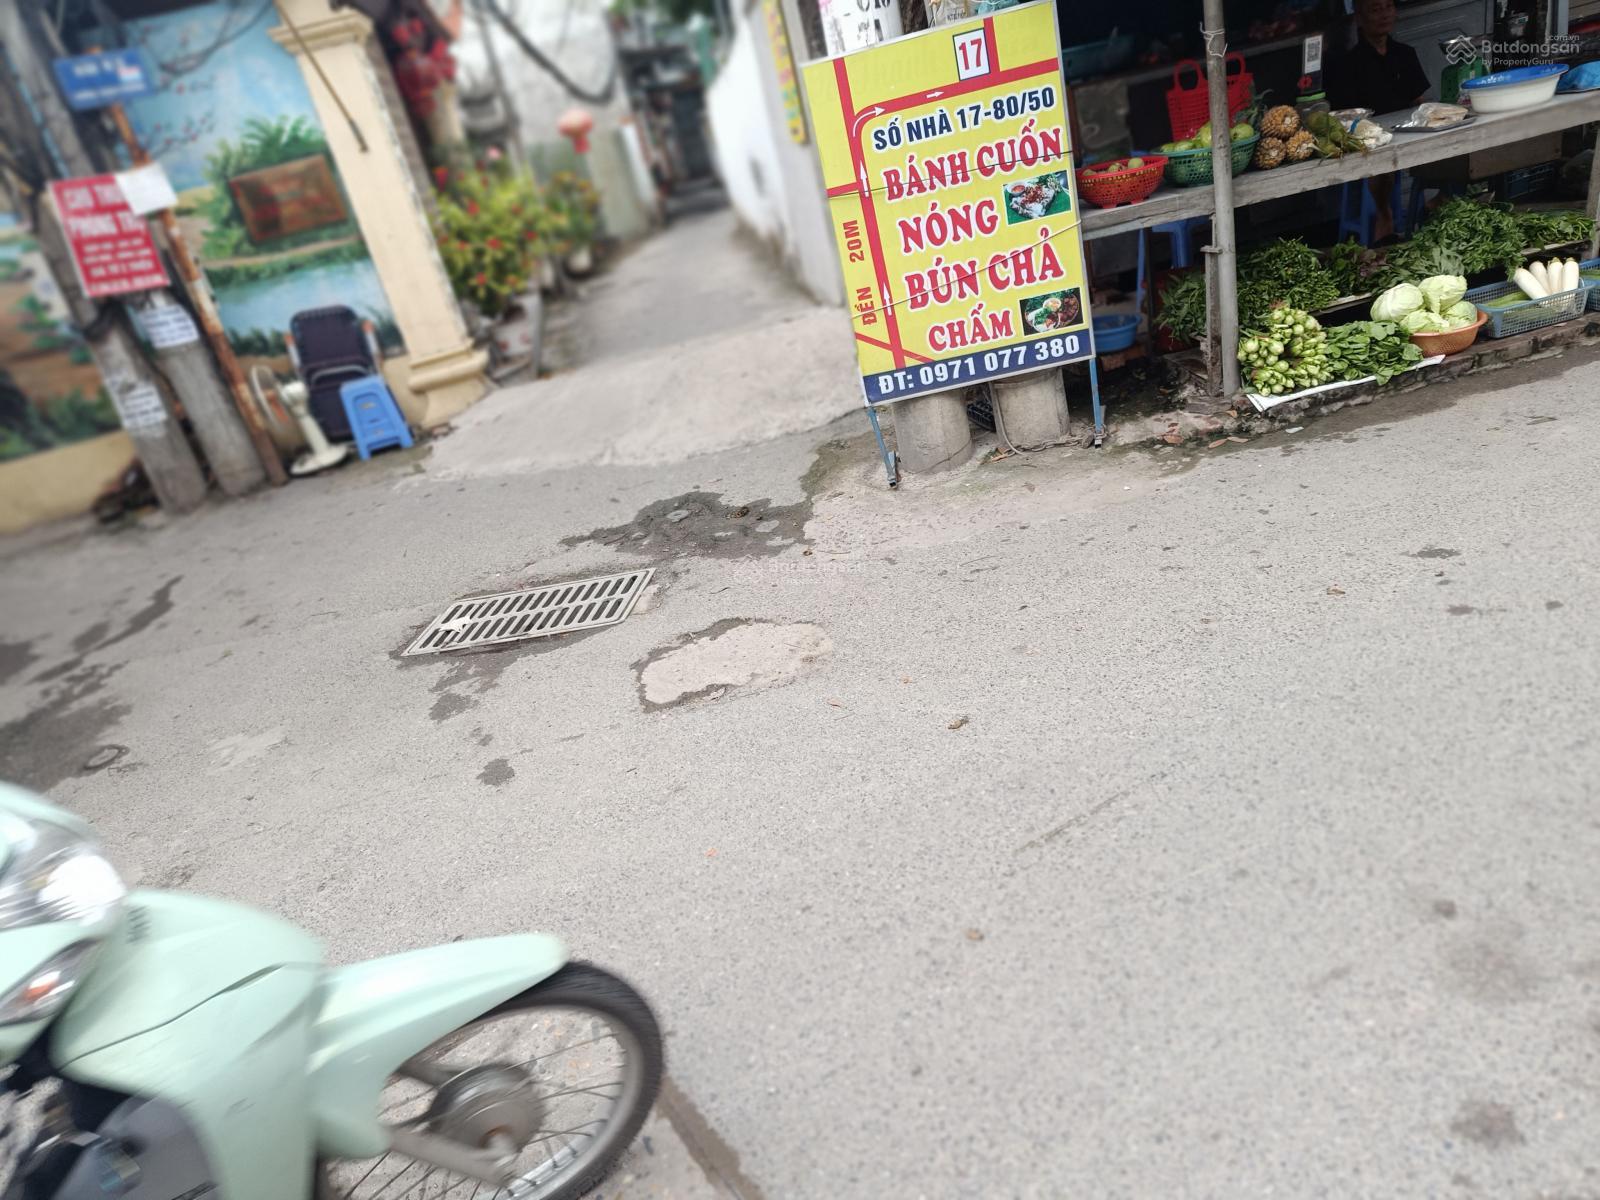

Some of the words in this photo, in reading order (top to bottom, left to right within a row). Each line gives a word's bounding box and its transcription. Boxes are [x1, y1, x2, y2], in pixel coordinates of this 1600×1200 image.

[958, 38, 983, 71] 17
[873, 118, 902, 150] SỐ
[907, 109, 952, 142] NHÀ
[956, 87, 1055, 130] 17-80/50
[883, 152, 971, 201] BÁNH
[976, 119, 1062, 177] CUỐN
[843, 219, 865, 263] 20M
[898, 200, 999, 253] NÓNG
[904, 257, 980, 310] BÚN
[988, 227, 1064, 290] CHẢ
[854, 287, 878, 326] ĐẾN
[928, 303, 1014, 351] CHẤM
[878, 371, 914, 394] ĐT:
[919, 356, 976, 386] 0971
[984, 345, 1028, 372] 077
[1034, 335, 1080, 361] 380
